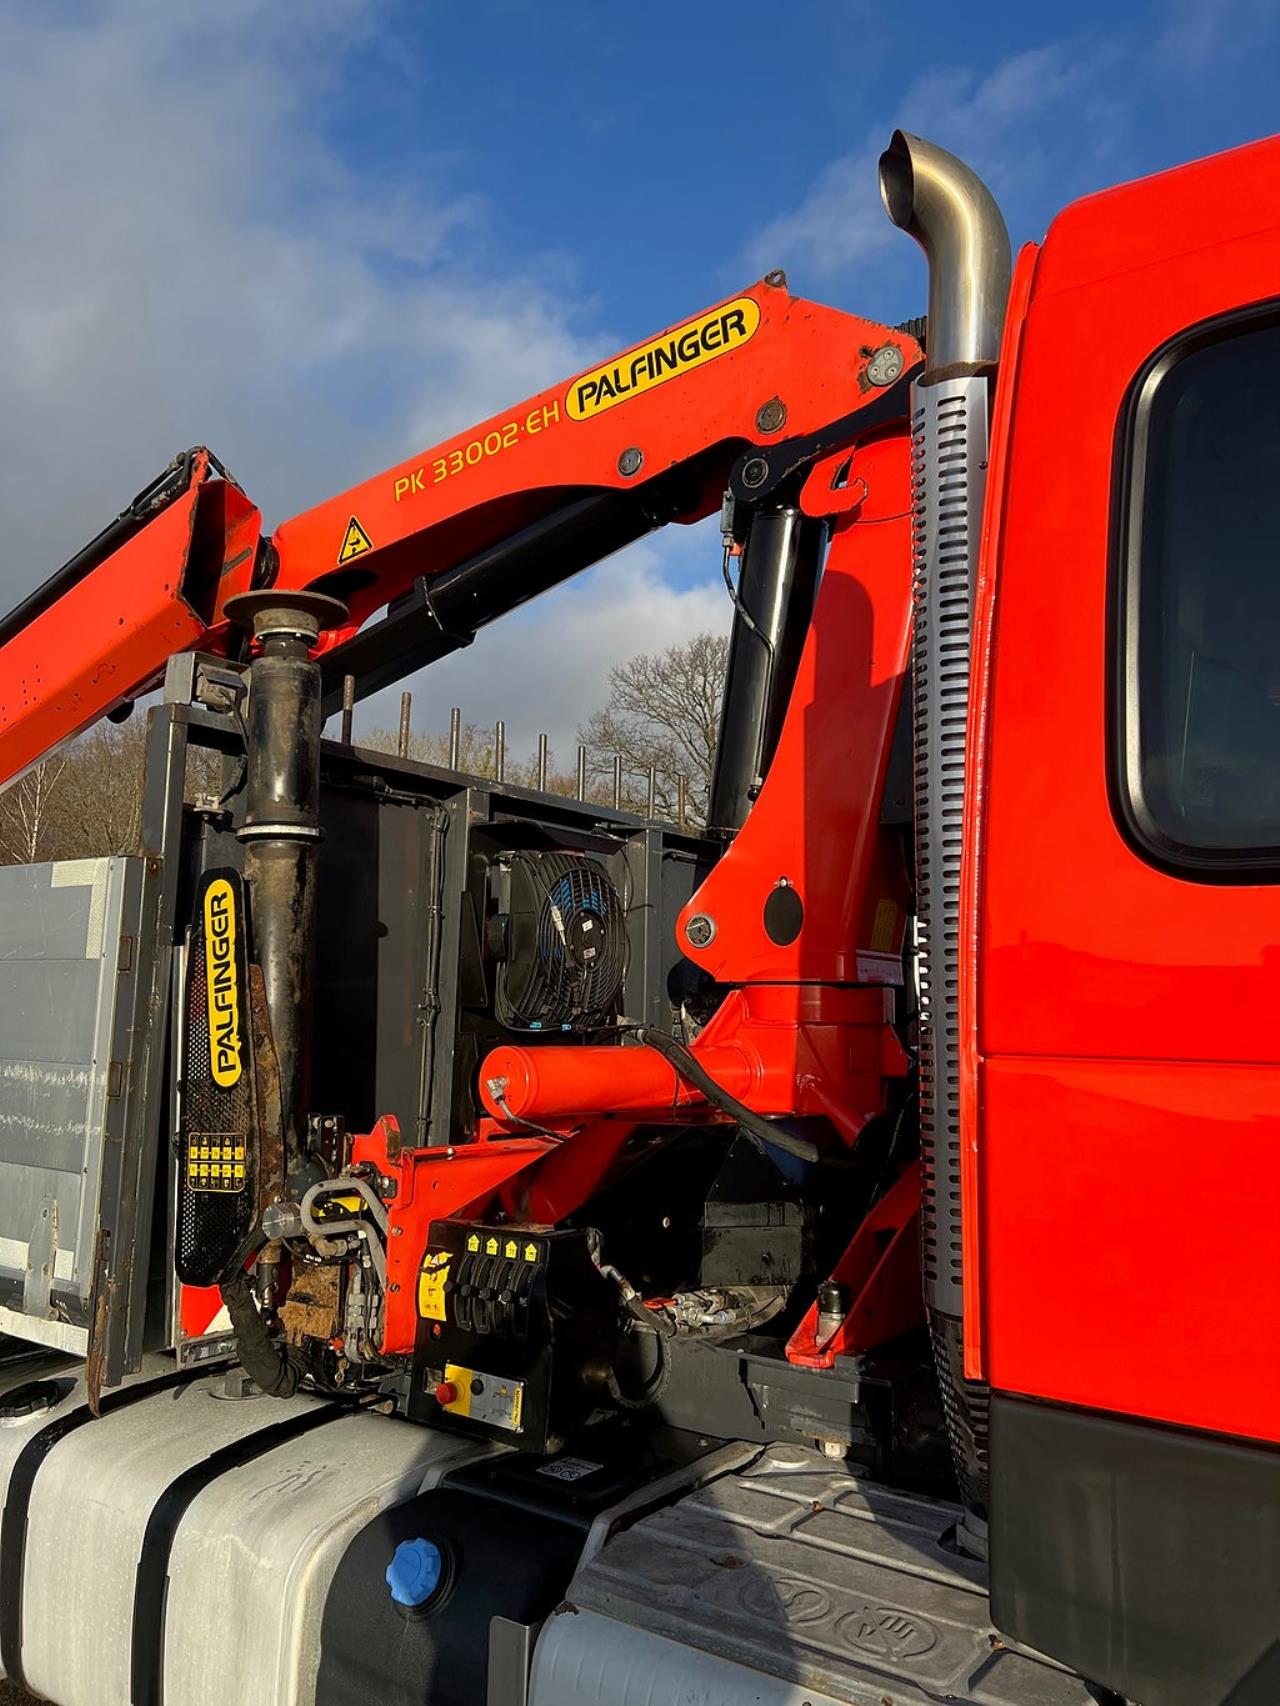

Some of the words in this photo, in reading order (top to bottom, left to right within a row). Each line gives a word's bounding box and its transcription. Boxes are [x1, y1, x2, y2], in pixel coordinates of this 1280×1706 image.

[577, 309, 747, 413] PALFINGER
[394, 468, 426, 502] PK
[210, 891, 235, 1074] PALFINGER
